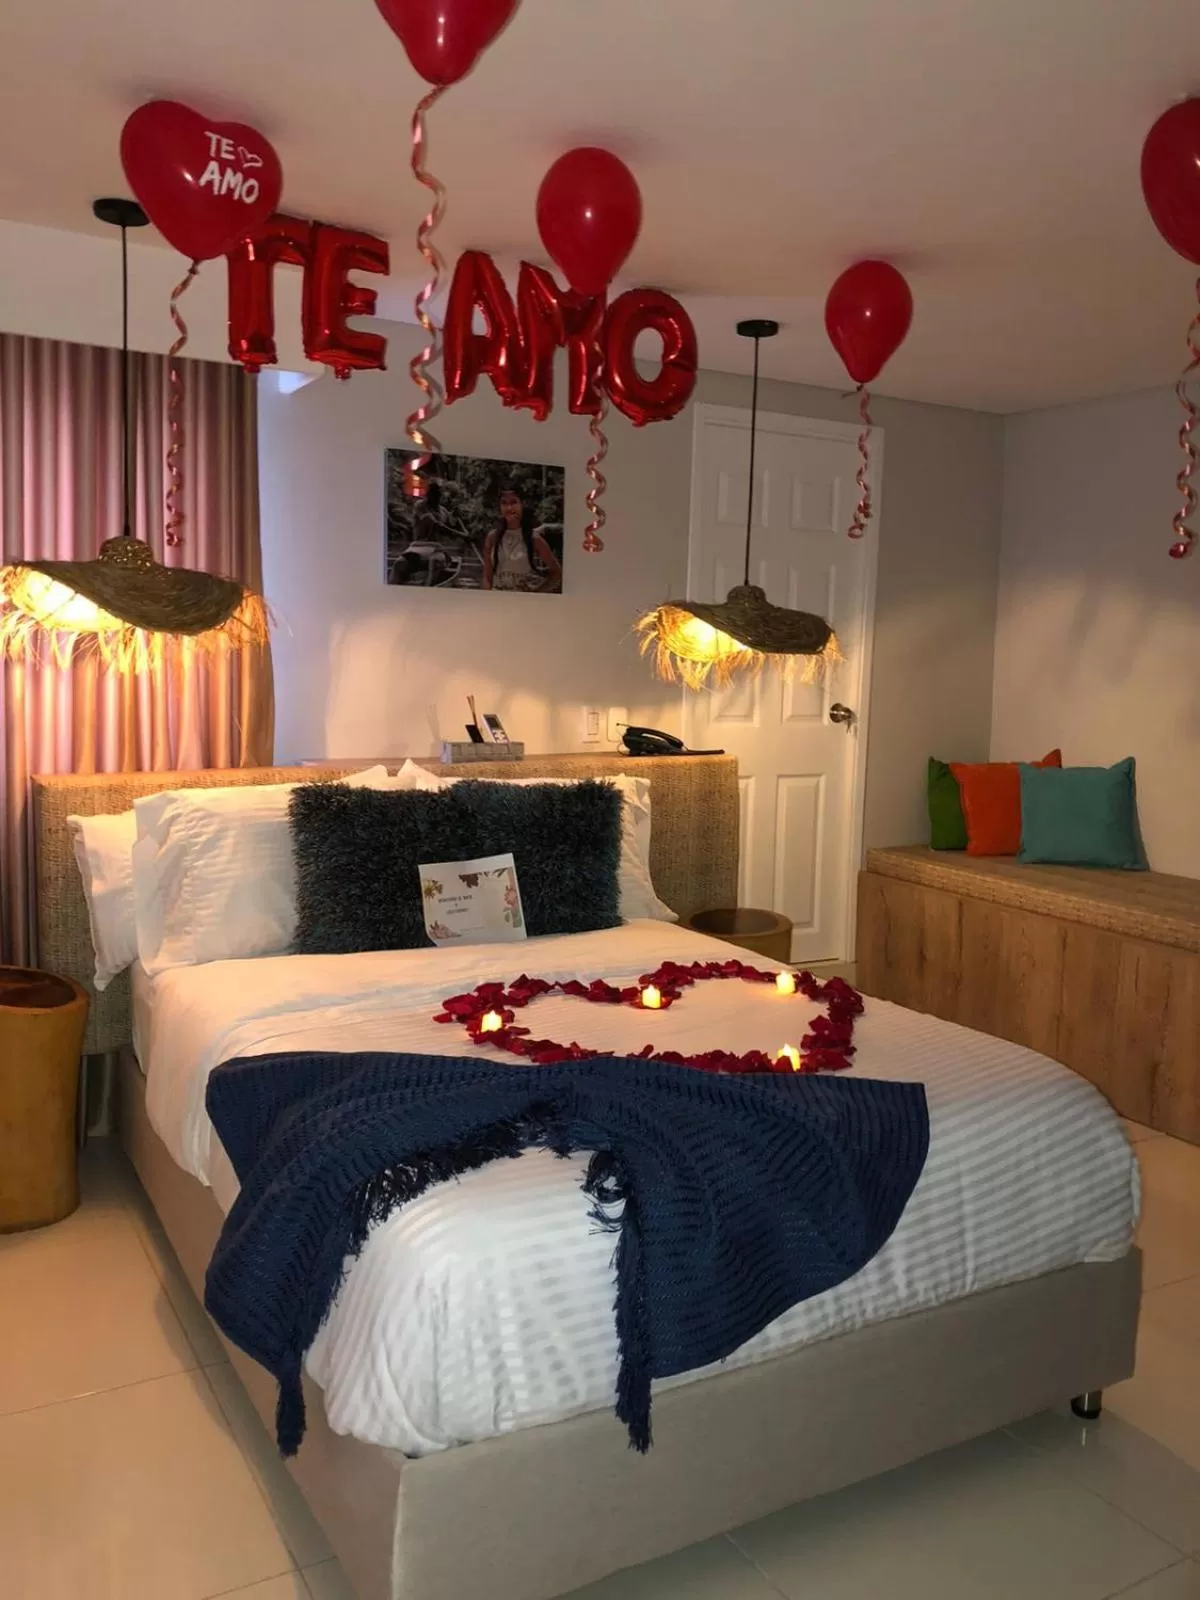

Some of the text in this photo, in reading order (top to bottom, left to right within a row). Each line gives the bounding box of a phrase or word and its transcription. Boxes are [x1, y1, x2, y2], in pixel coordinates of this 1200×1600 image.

[203, 131, 236, 160] TE
[199, 160, 259, 204] AMO
[226, 213, 698, 427] TE AMO
